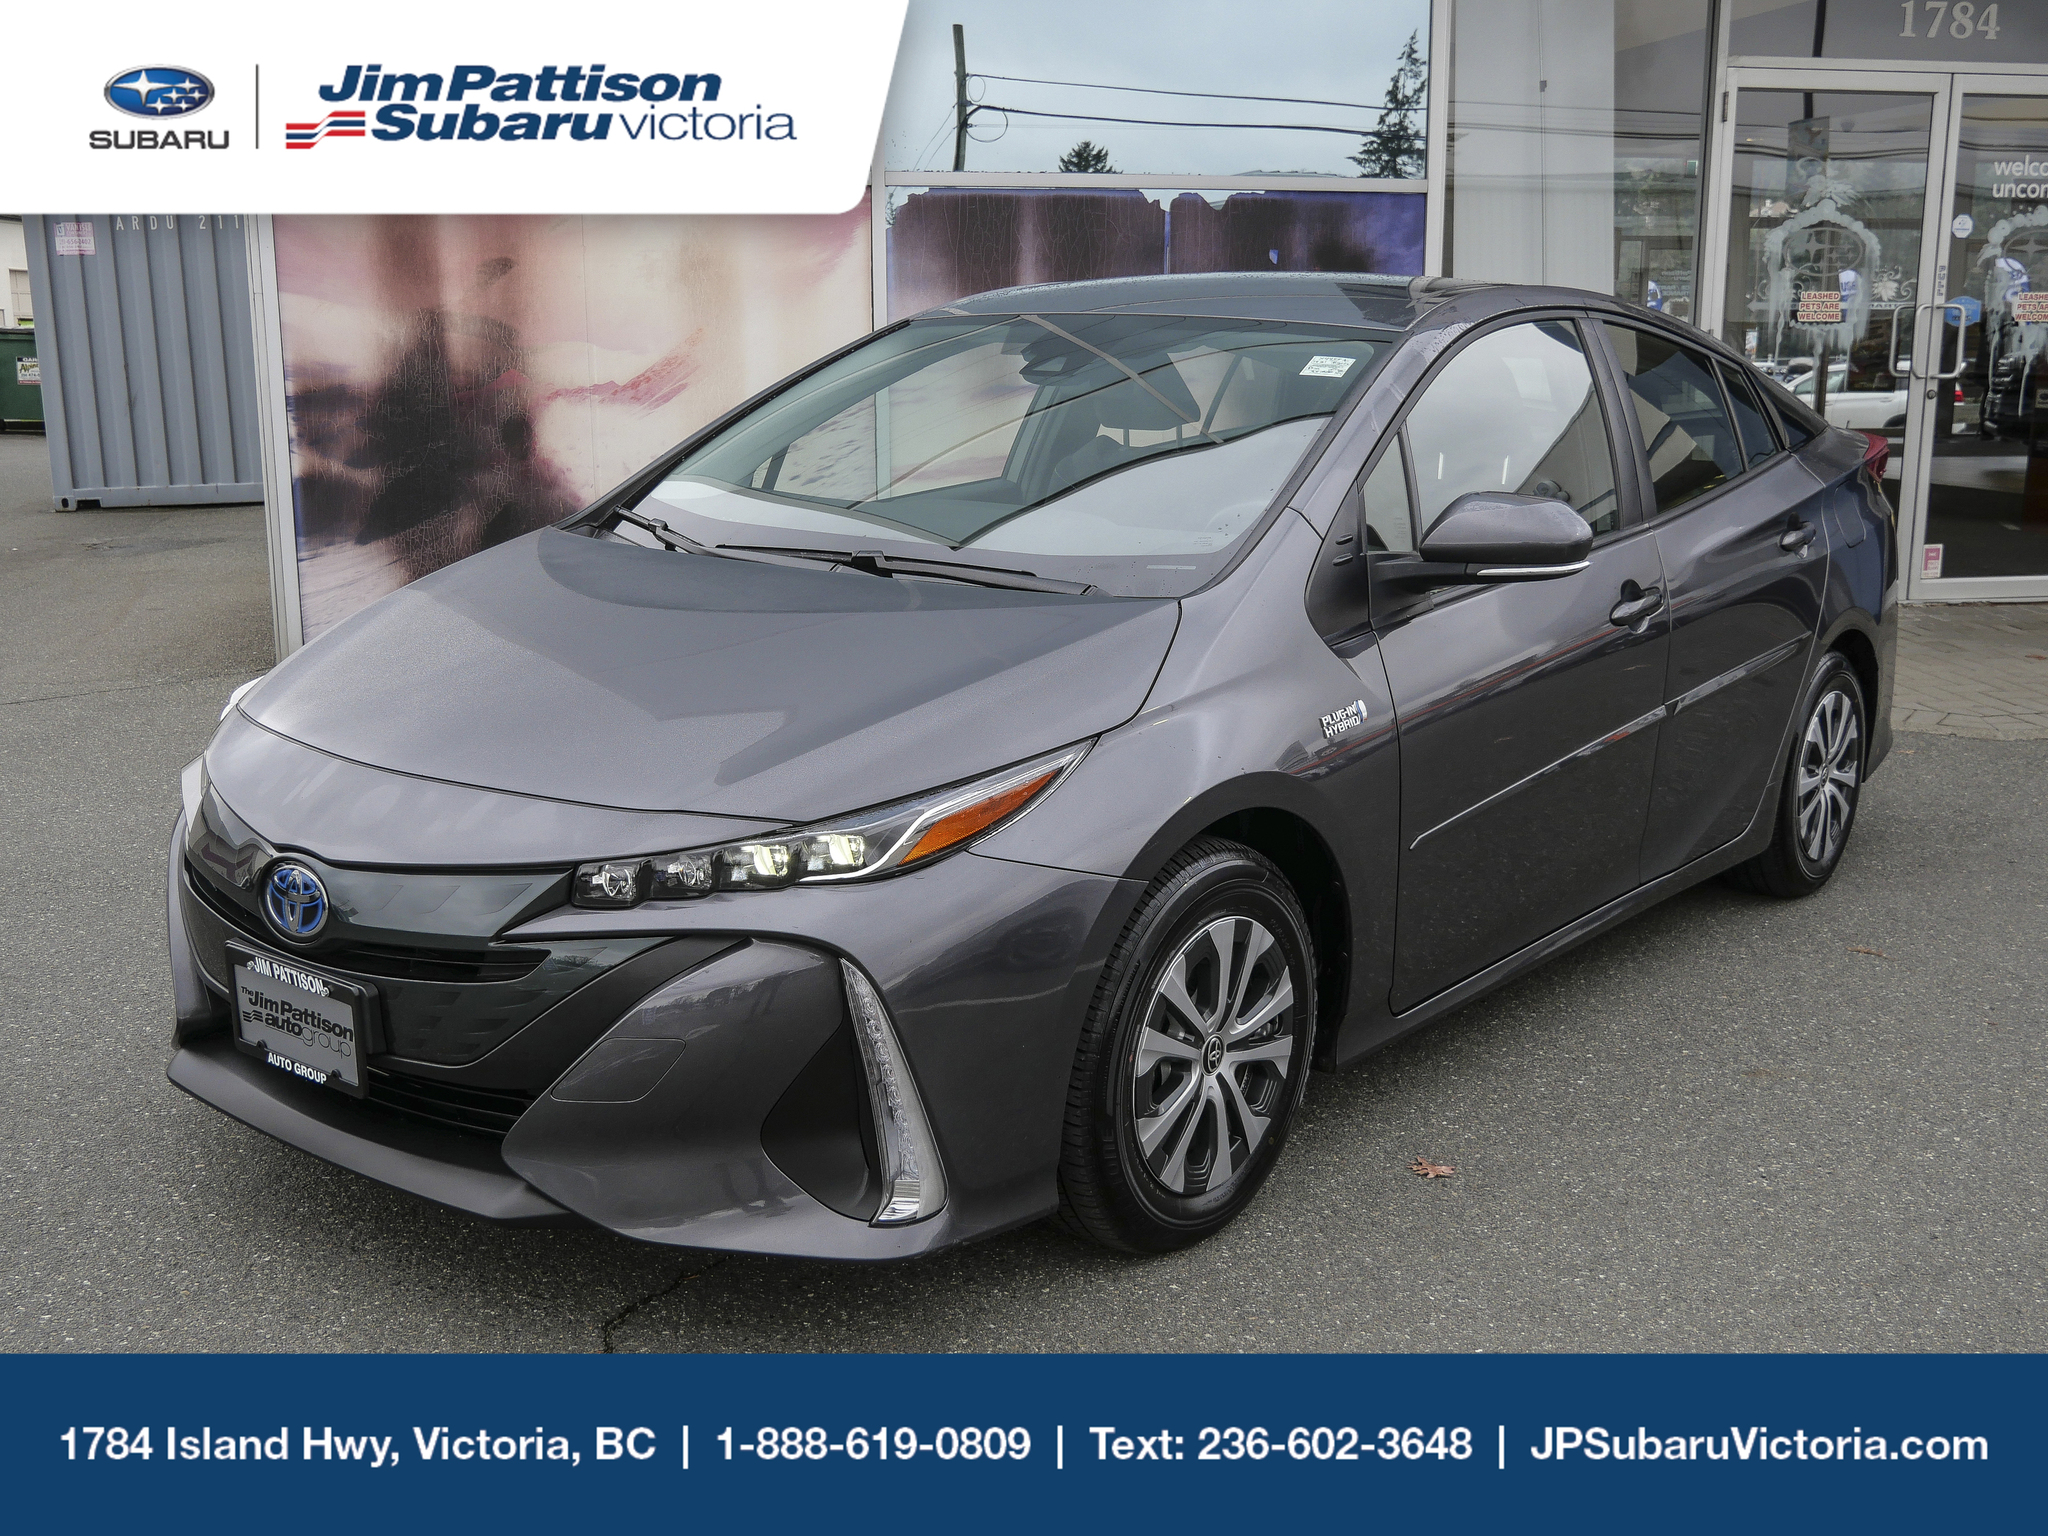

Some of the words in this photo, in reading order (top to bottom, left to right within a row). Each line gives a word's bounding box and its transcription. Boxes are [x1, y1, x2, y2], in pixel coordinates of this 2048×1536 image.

[1899, 0, 2000, 39] 1784
[116, 215, 175, 230] ARDU
[1801, 292, 1840, 300] LEASHED
[1800, 302, 1821, 310] PETS
[1822, 302, 1840, 310] ARE
[2016, 303, 2037, 311] PETS
[1798, 312, 1840, 321] WELCOME
[1321, 703, 1357, 727] PLUG-IN
[1324, 714, 1361, 738] HYBRID
[254, 957, 272, 977] JIM
[272, 963, 323, 995] PATTISON
[241, 986, 254, 997] The
[268, 1052, 292, 1072] AUTO
[293, 1062, 327, 1084] GROUP
